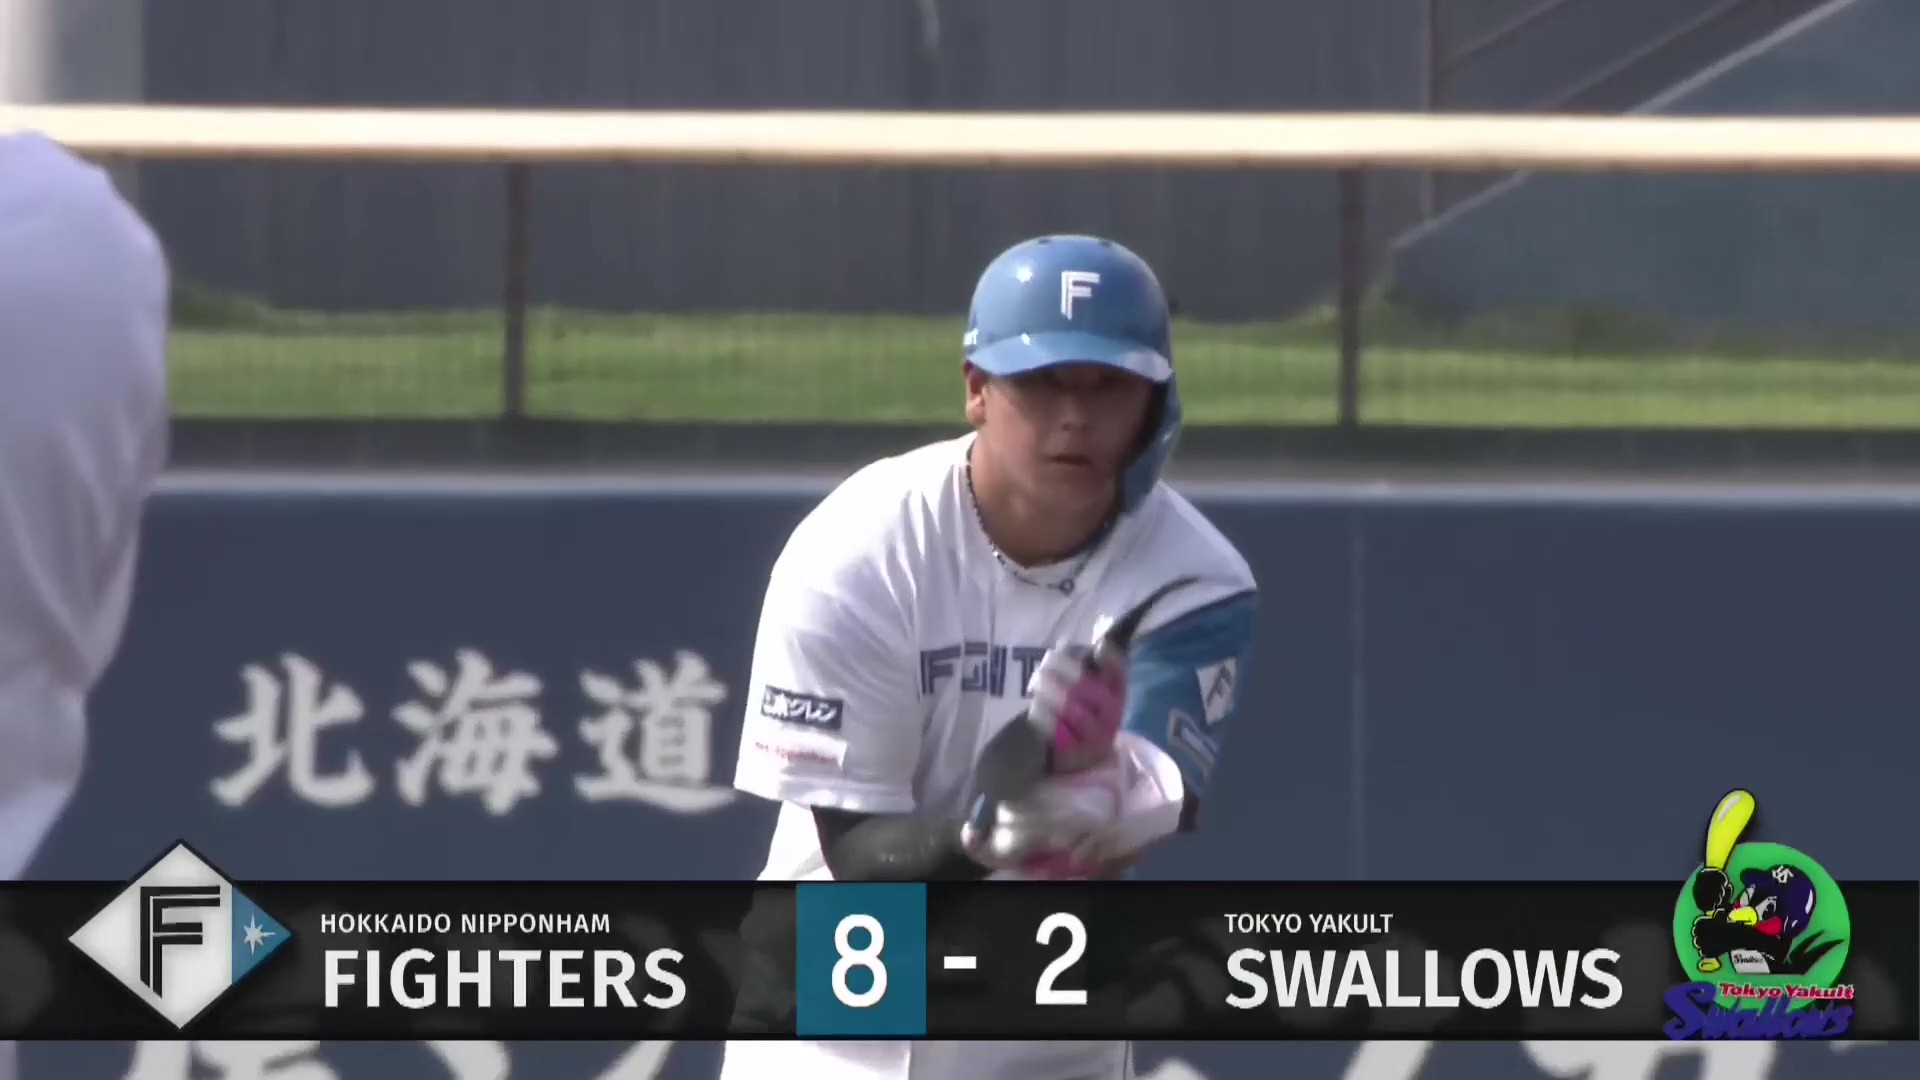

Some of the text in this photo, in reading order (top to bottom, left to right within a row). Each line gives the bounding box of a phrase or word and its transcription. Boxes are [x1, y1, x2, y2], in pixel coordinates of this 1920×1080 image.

[1060, 269, 1101, 320] F
[211, 649, 735, 816] 北海道
